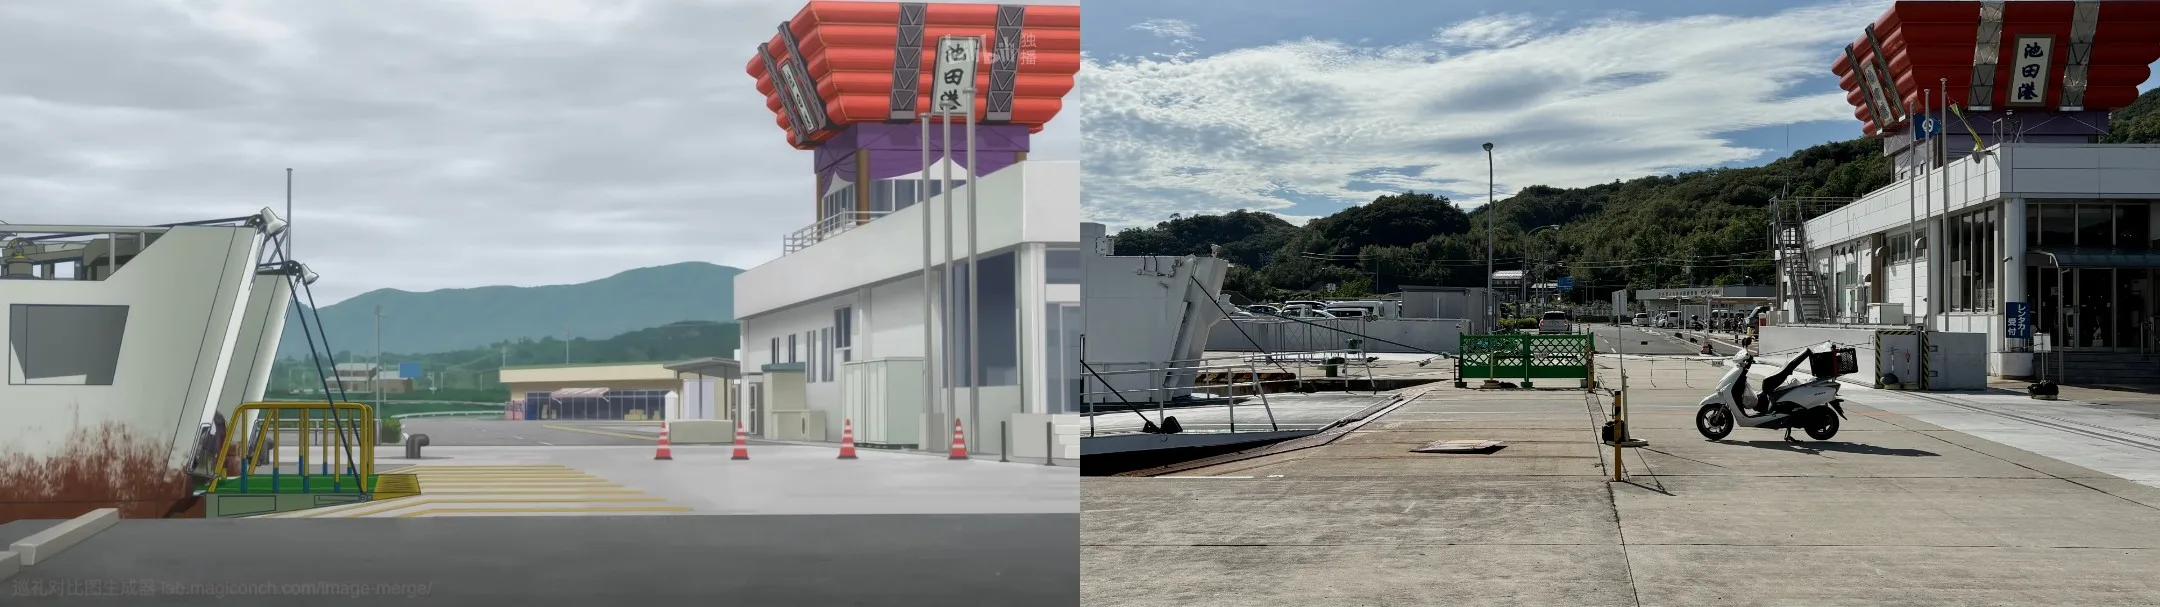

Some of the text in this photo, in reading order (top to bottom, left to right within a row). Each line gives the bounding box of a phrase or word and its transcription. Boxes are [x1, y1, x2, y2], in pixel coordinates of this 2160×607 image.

[2017, 41, 2044, 100] 池田港
[2008, 317, 2017, 336] 受付
[2017, 304, 2026, 336] レンタカー
